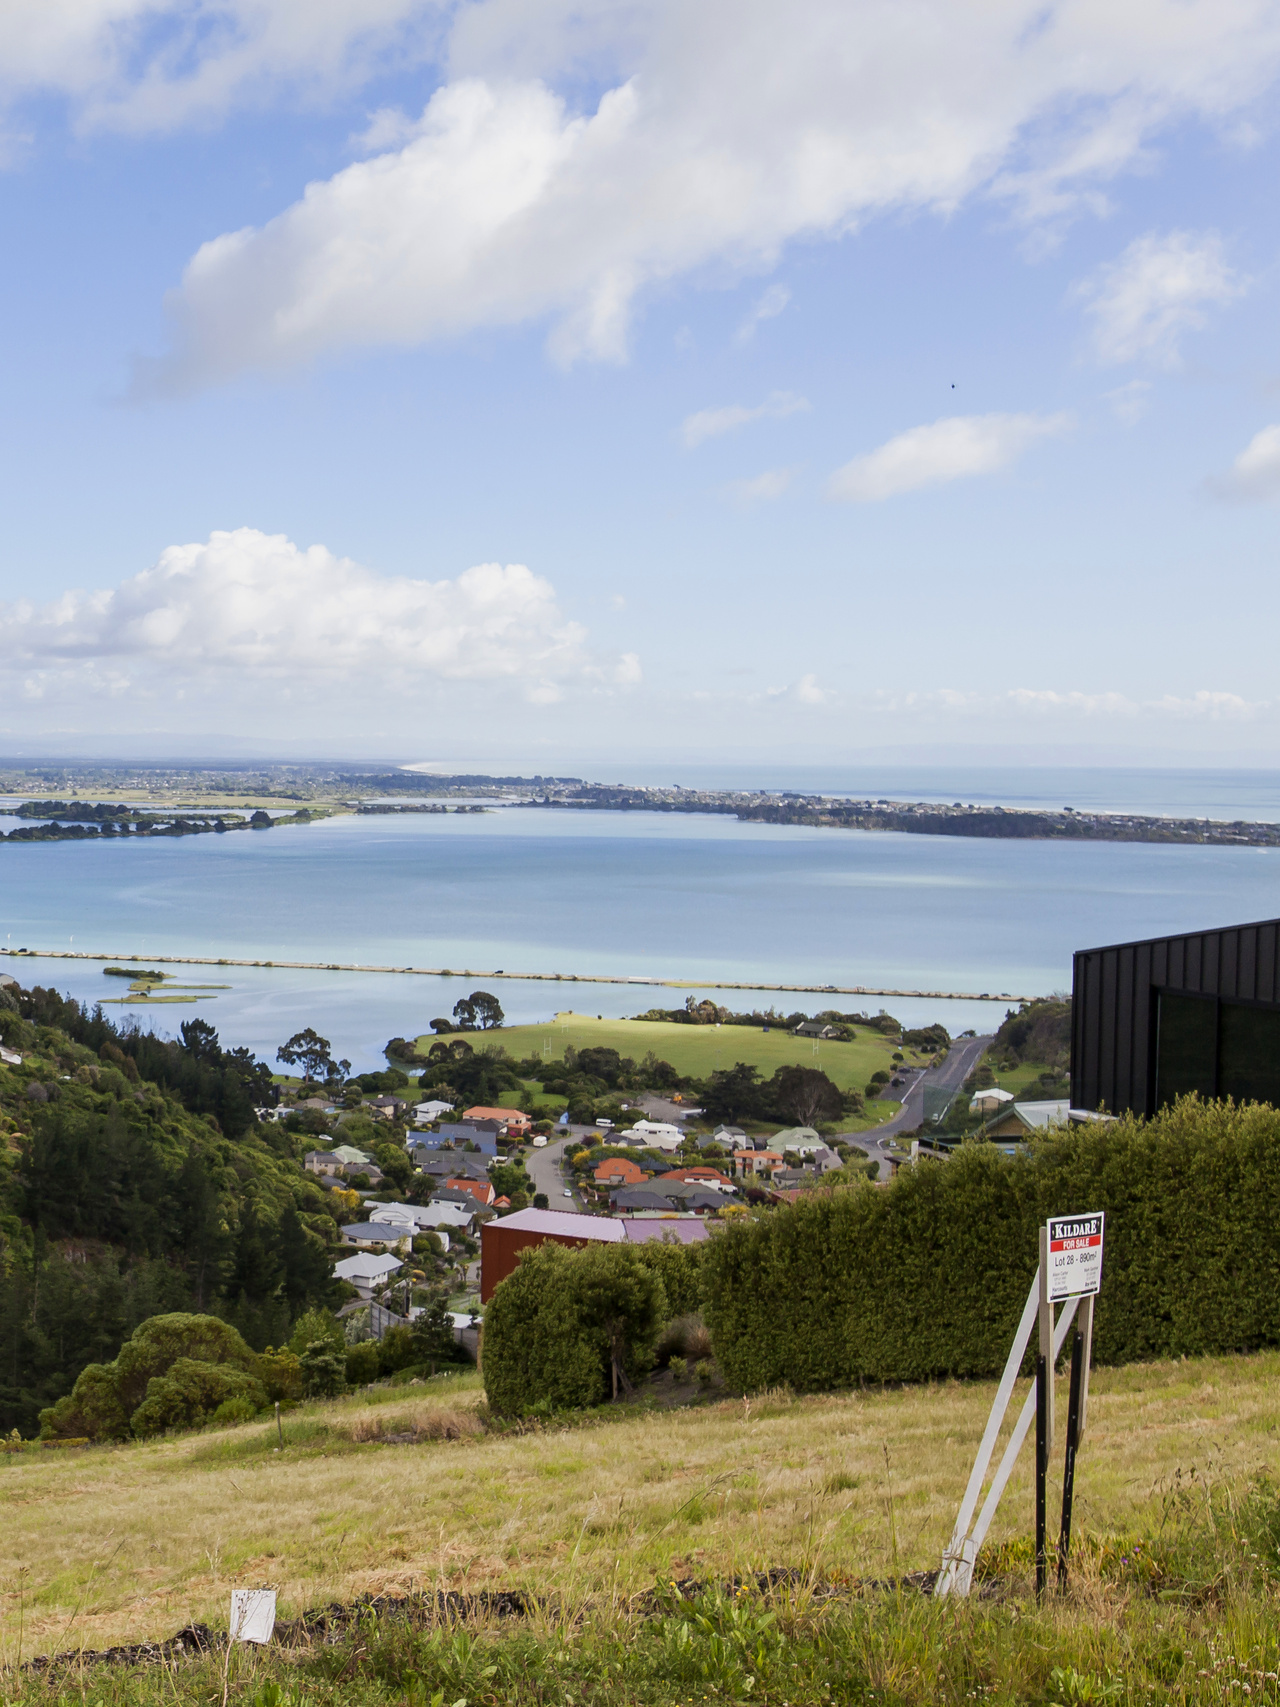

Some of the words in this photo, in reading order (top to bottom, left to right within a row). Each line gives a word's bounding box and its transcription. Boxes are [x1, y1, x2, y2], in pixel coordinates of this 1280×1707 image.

[1055, 1220, 1097, 1238] KILDARE
[1063, 1240, 1075, 1250] FOR
[1075, 1239, 1089, 1248] SALE
[1055, 1257, 1065, 1266] Lot
[1066, 1254, 1074, 1265] 28
